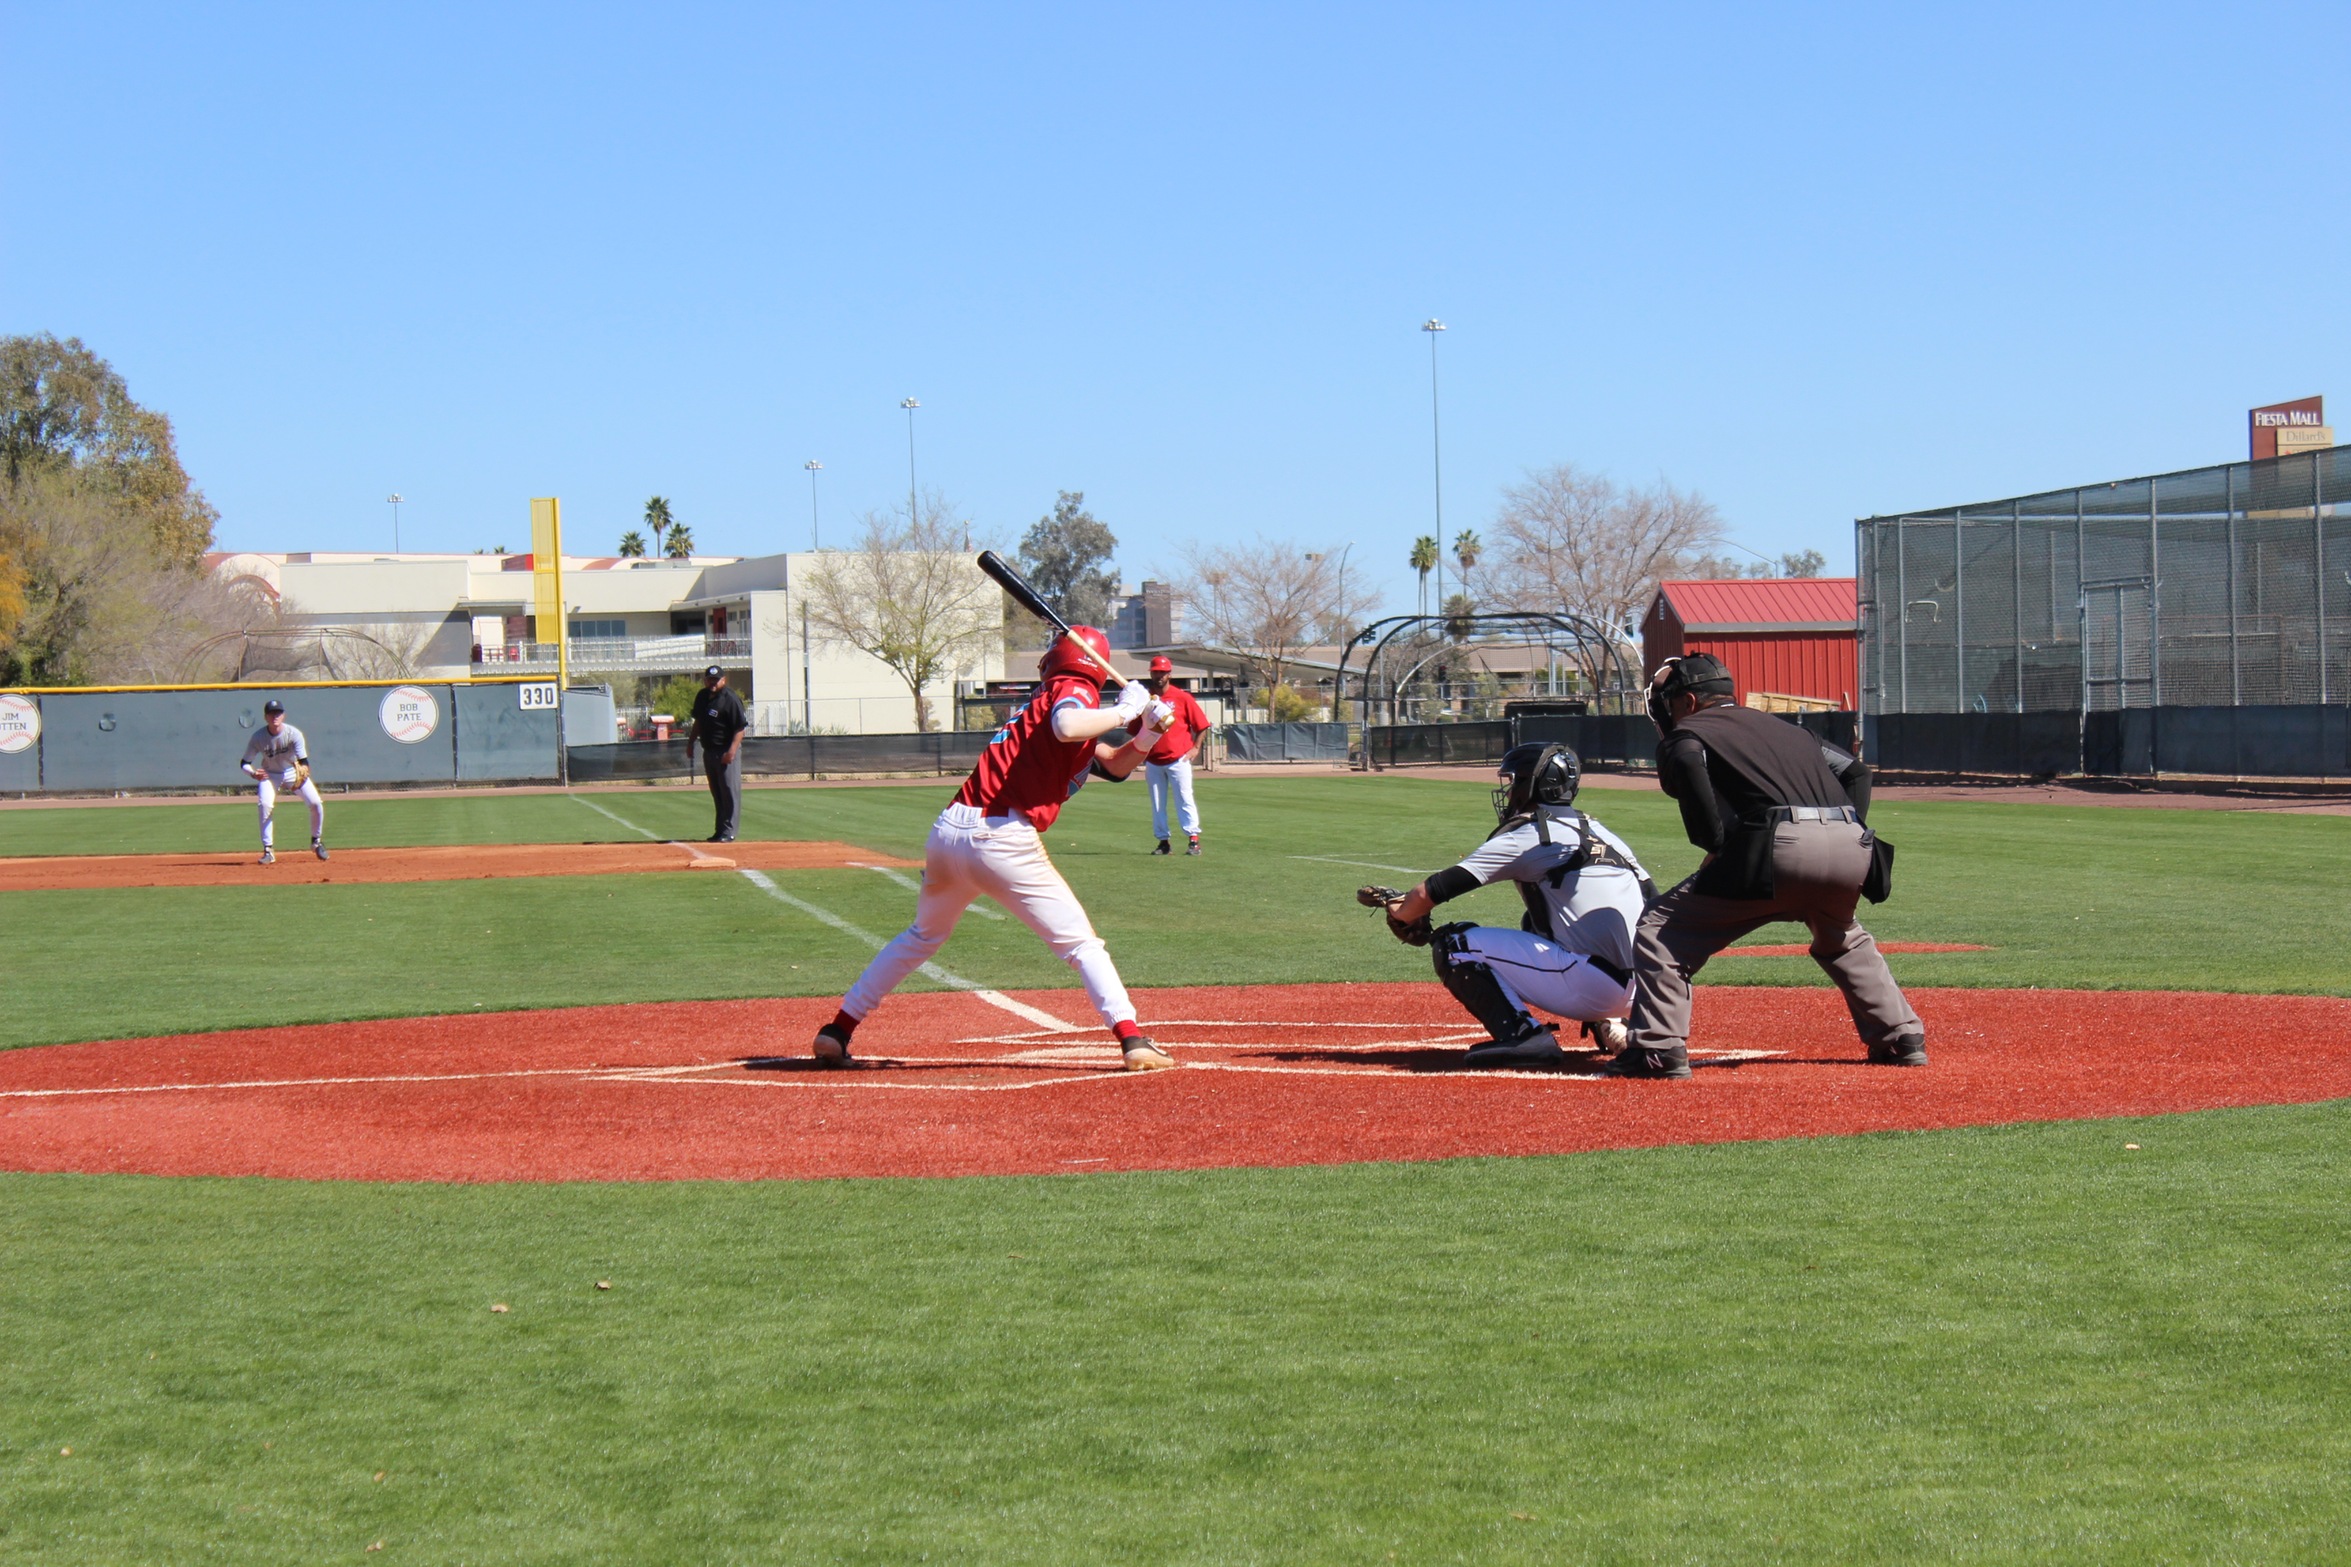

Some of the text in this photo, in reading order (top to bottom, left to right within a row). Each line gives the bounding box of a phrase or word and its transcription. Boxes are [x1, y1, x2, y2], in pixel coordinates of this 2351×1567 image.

[2255, 410, 2320, 427] FIESTA MALL
[523, 687, 554, 705] 330
[400, 703, 418, 712] BOB
[2, 712, 20, 721] JIM
[397, 713, 422, 721] PATE
[0, 722, 27, 731] TTEN
